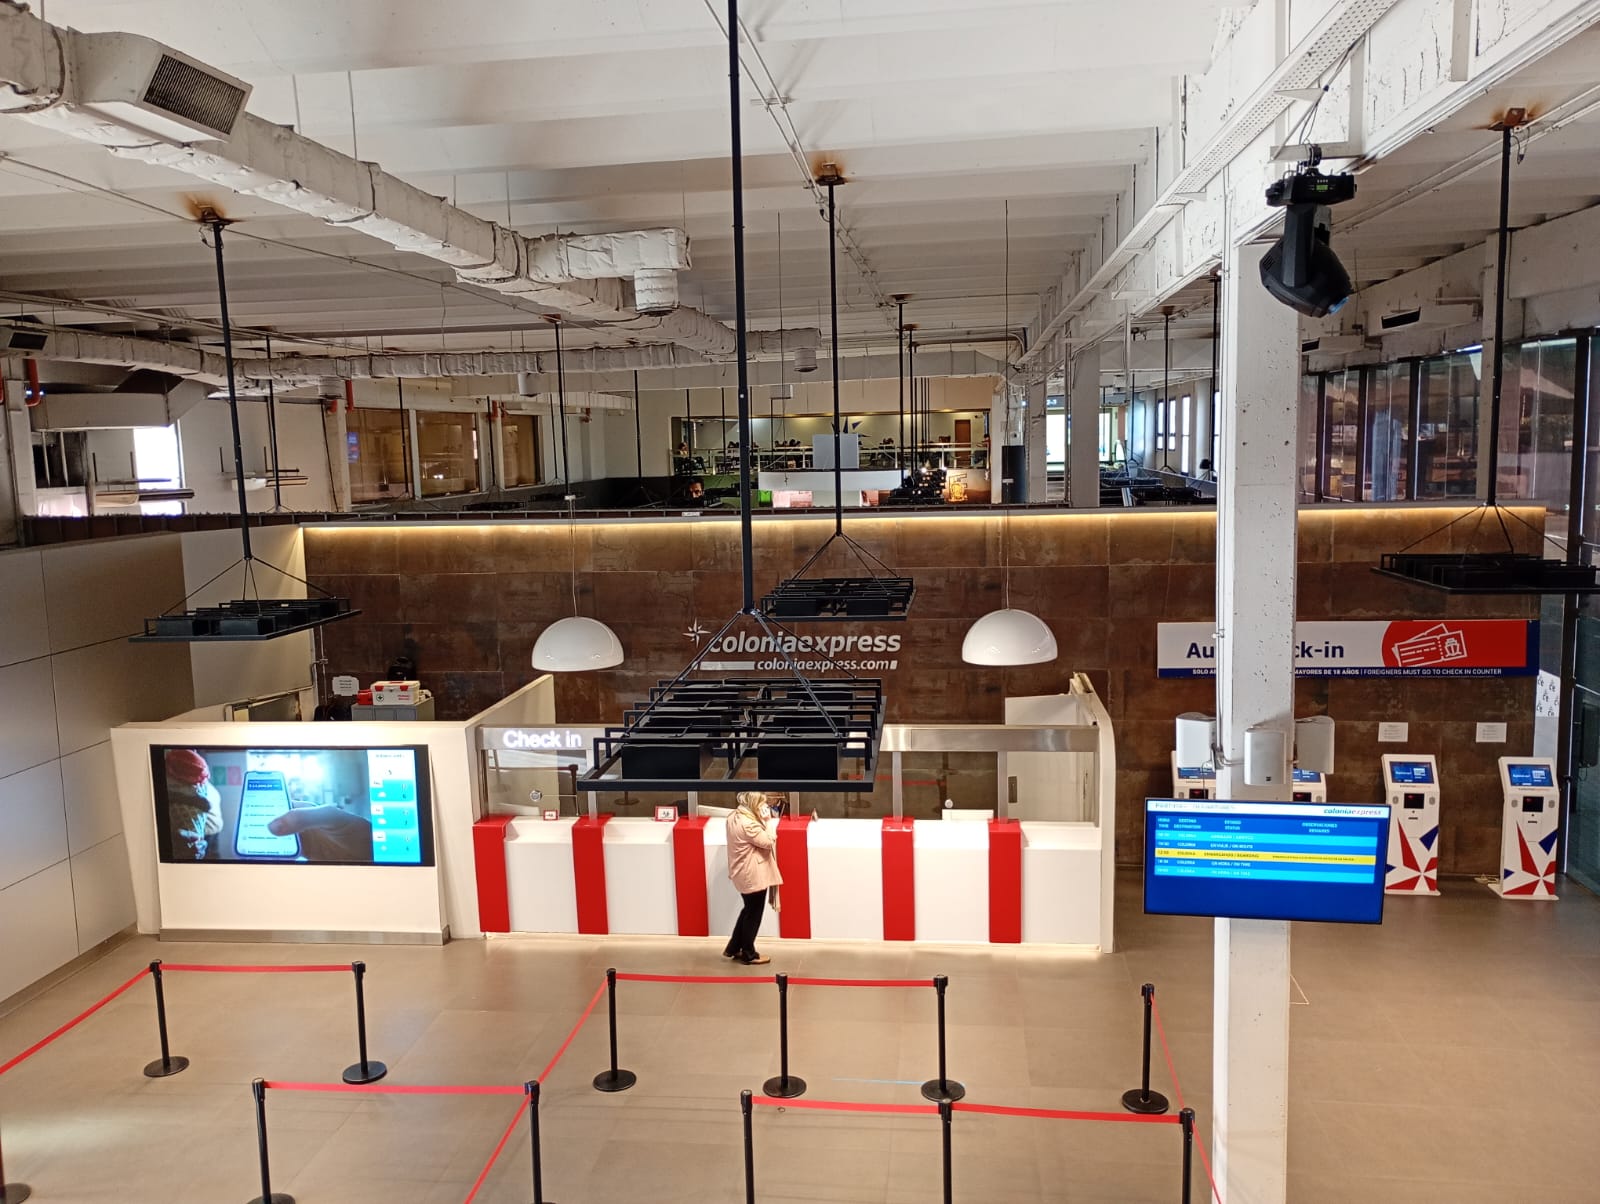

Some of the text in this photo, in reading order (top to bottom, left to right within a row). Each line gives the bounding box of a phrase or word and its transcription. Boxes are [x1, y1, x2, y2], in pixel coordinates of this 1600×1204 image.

[709, 631, 901, 657] coloniaexpress
[502, 730, 582, 748] Check in
